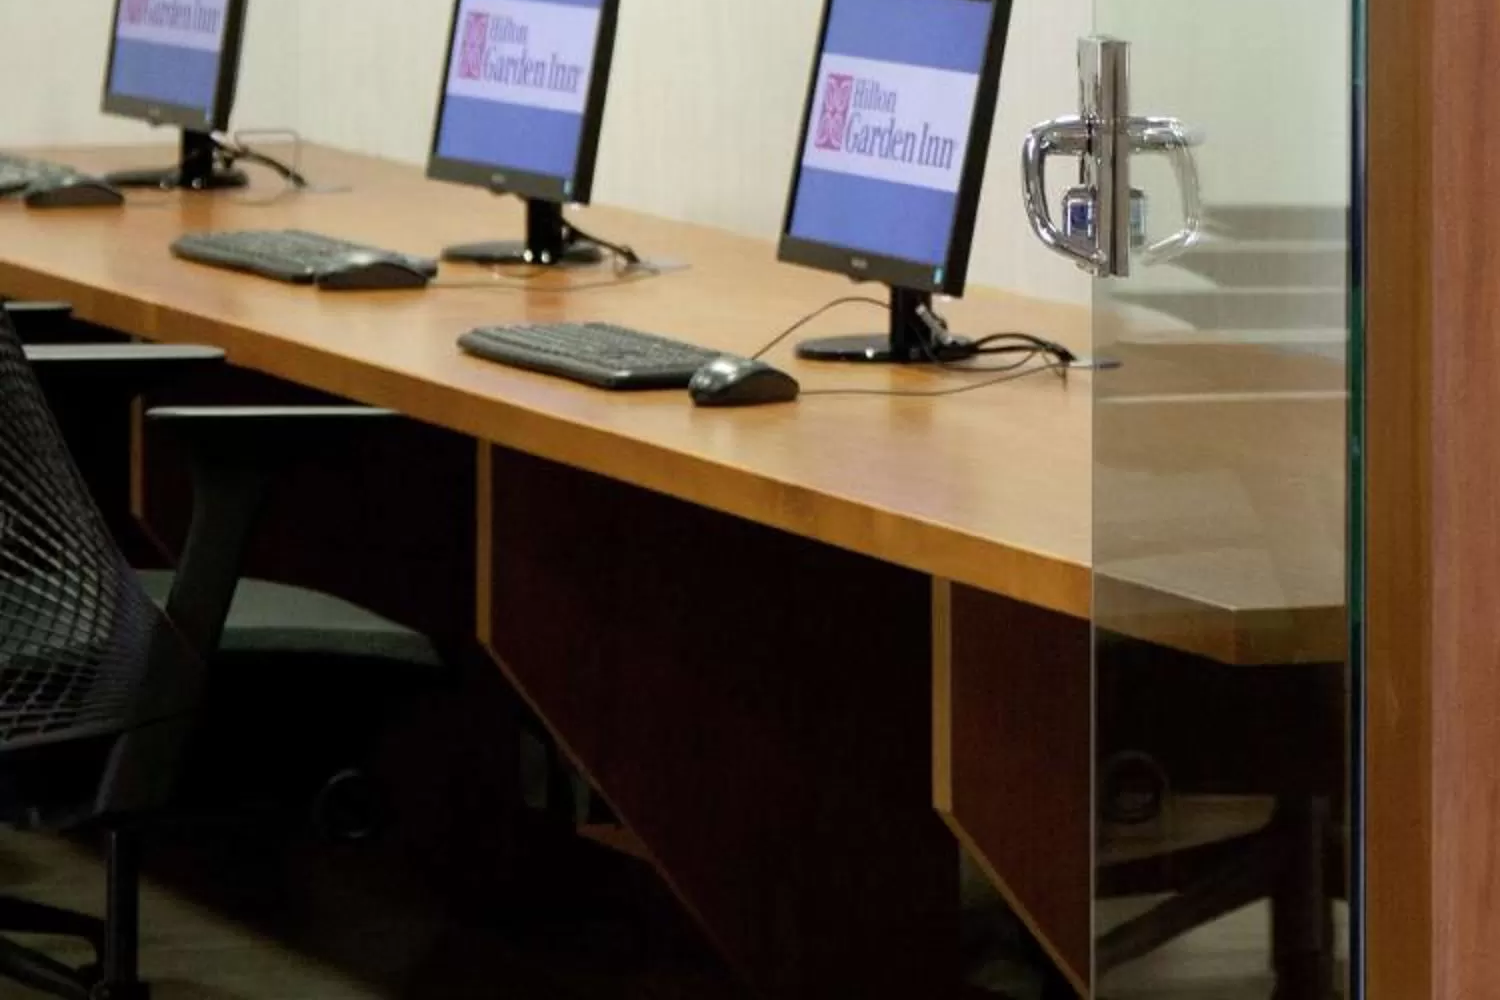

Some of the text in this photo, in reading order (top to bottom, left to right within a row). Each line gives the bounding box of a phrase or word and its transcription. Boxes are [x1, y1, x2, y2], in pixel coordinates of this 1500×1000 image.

[852, 77, 897, 113] Hilton
[845, 111, 955, 171] Garden Inn
